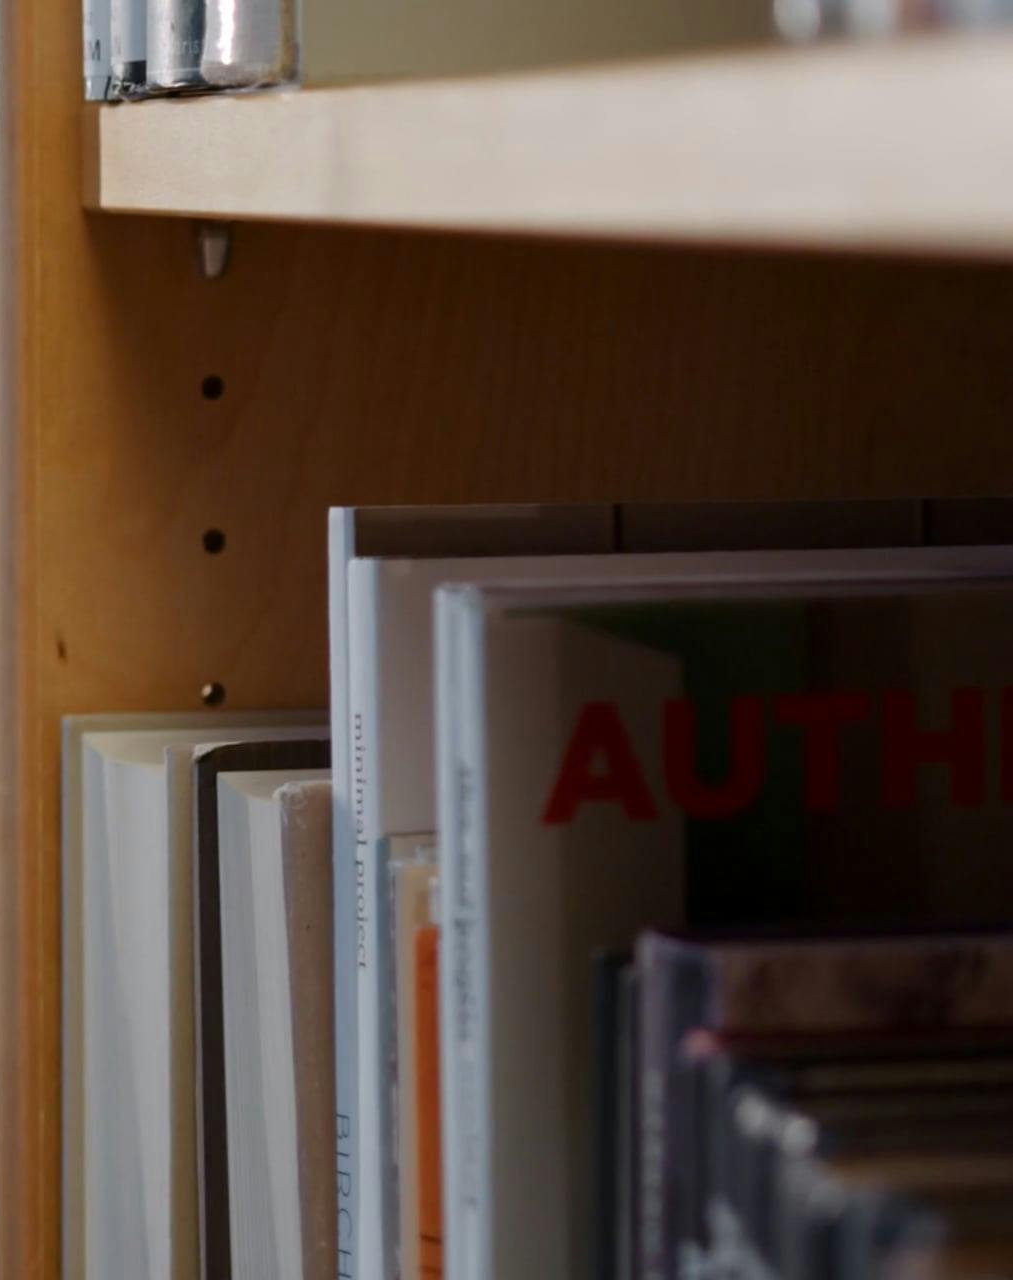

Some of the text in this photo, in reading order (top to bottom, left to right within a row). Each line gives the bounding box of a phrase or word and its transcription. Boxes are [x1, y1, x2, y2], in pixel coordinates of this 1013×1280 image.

[539, 685, 1013, 826] AUTH
[353, 713, 370, 970] minimal project
[334, 1111, 354, 1280] BIRCH
